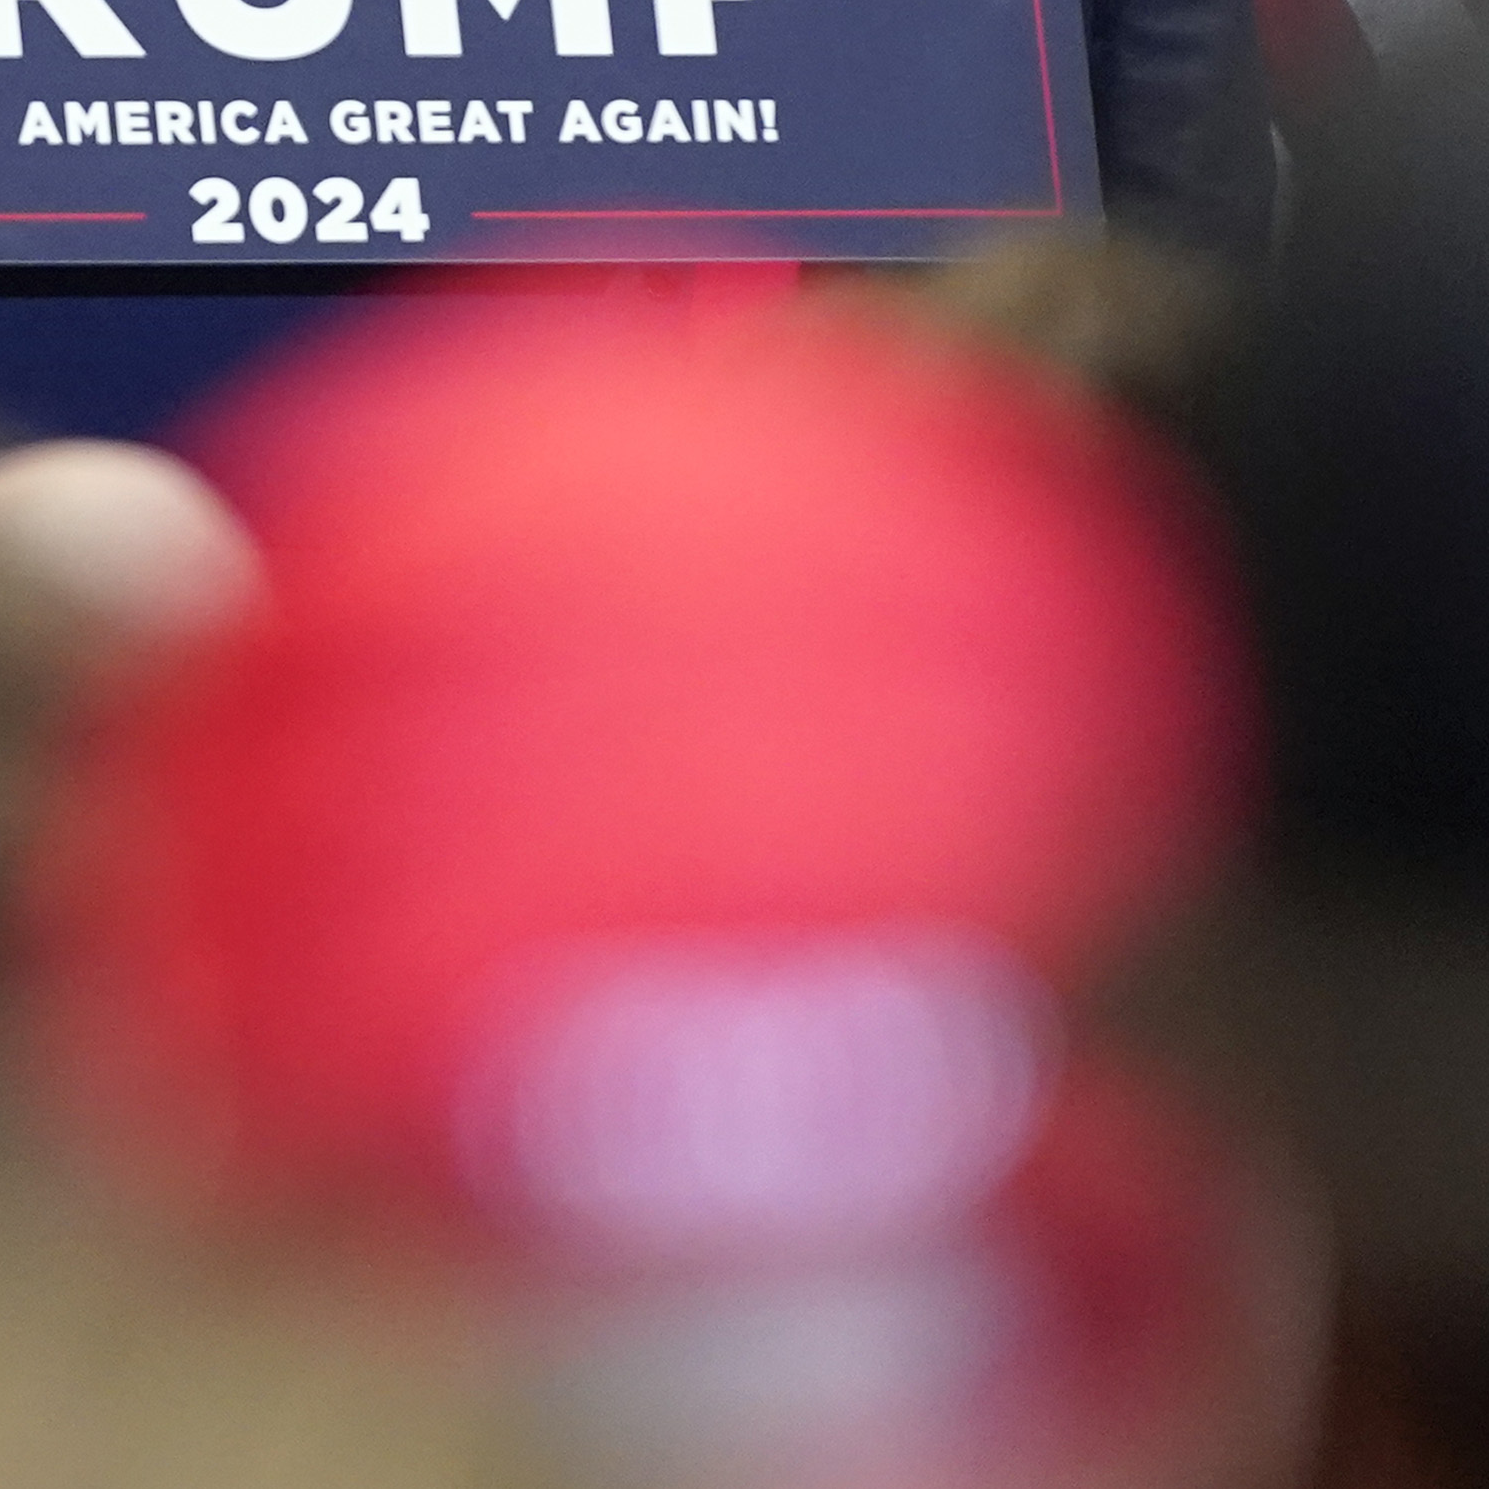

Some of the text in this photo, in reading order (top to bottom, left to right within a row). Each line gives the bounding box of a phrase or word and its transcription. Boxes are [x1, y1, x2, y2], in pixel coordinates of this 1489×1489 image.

[17, 99, 310, 146] AMERICA
[328, 98, 535, 145] GREAT
[557, 97, 781, 144] AGAIN!
[187, 175, 431, 246] 2024
